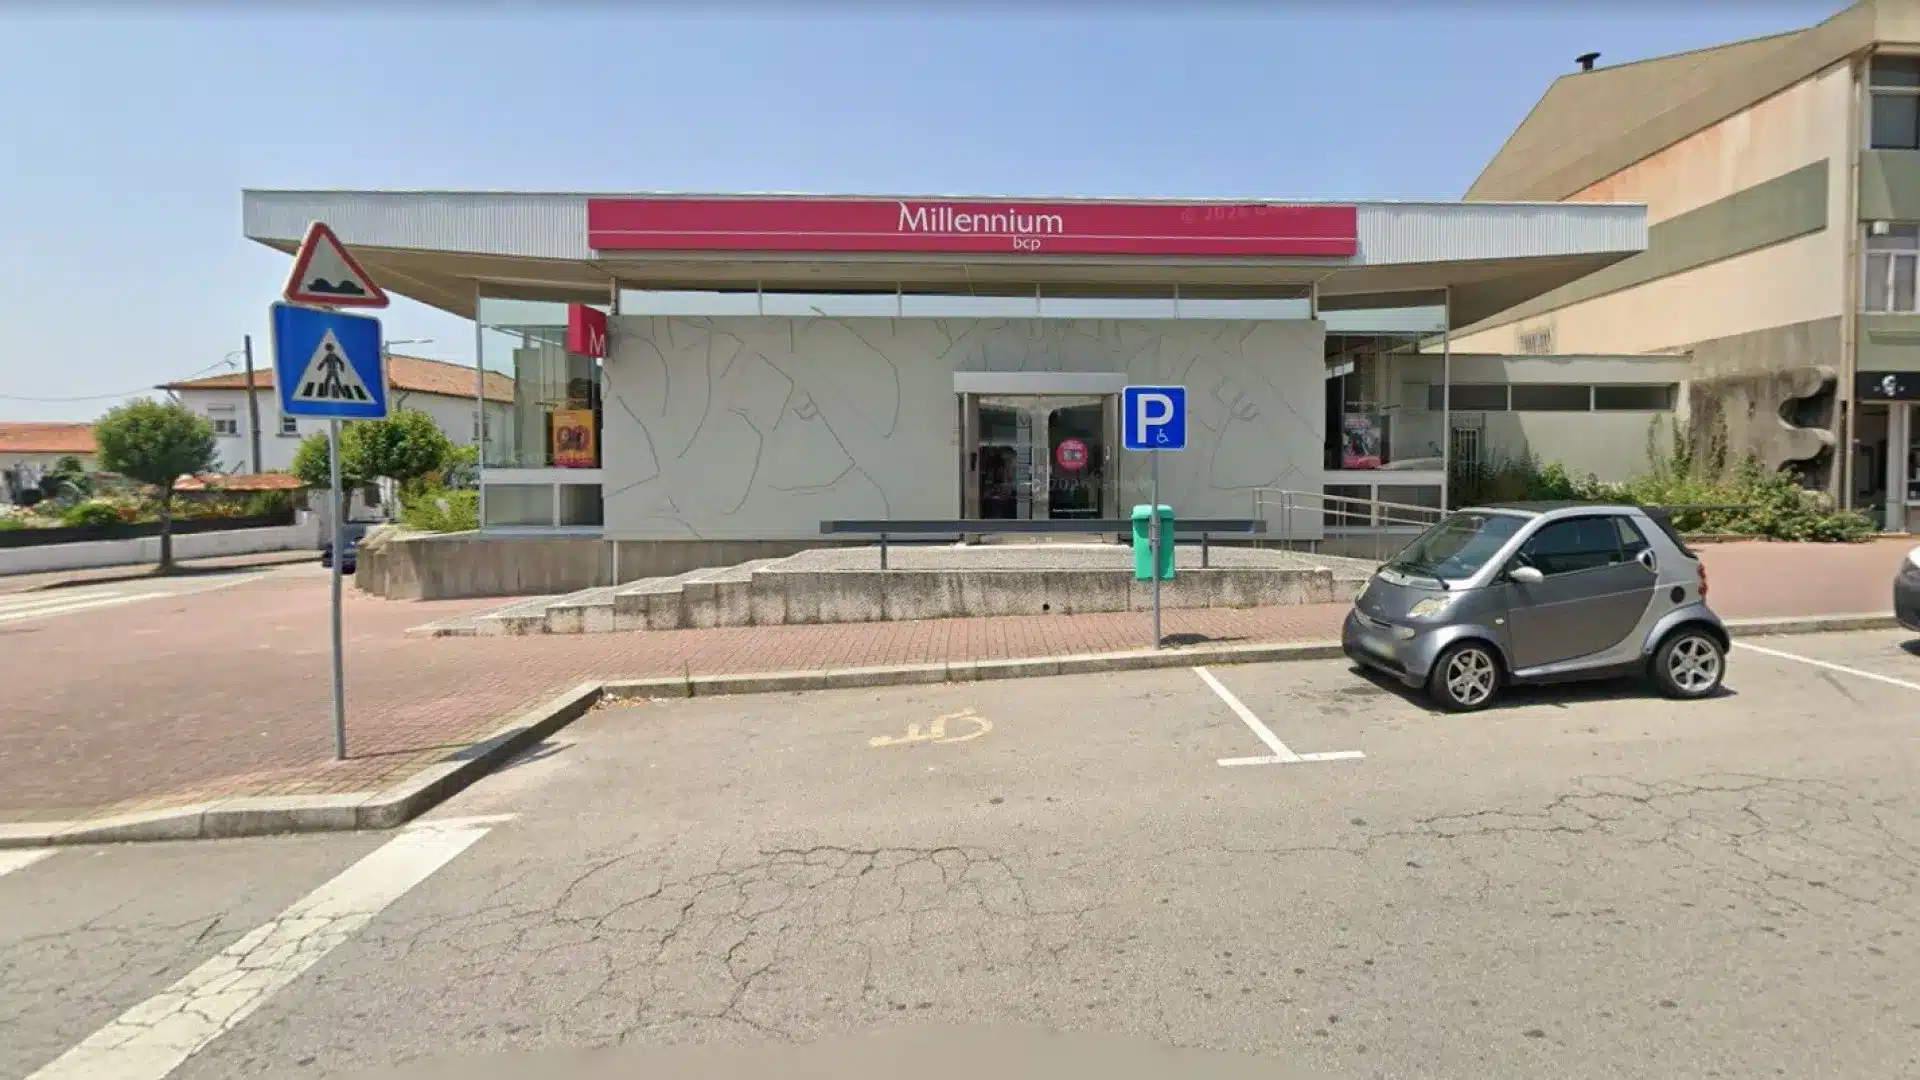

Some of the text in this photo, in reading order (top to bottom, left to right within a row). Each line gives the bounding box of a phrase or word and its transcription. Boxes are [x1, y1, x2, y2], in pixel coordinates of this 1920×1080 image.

[898, 201, 1063, 233] Millennium
[1012, 236, 1041, 251] bcp
[588, 324, 606, 356] M
[1137, 394, 1174, 443] P
